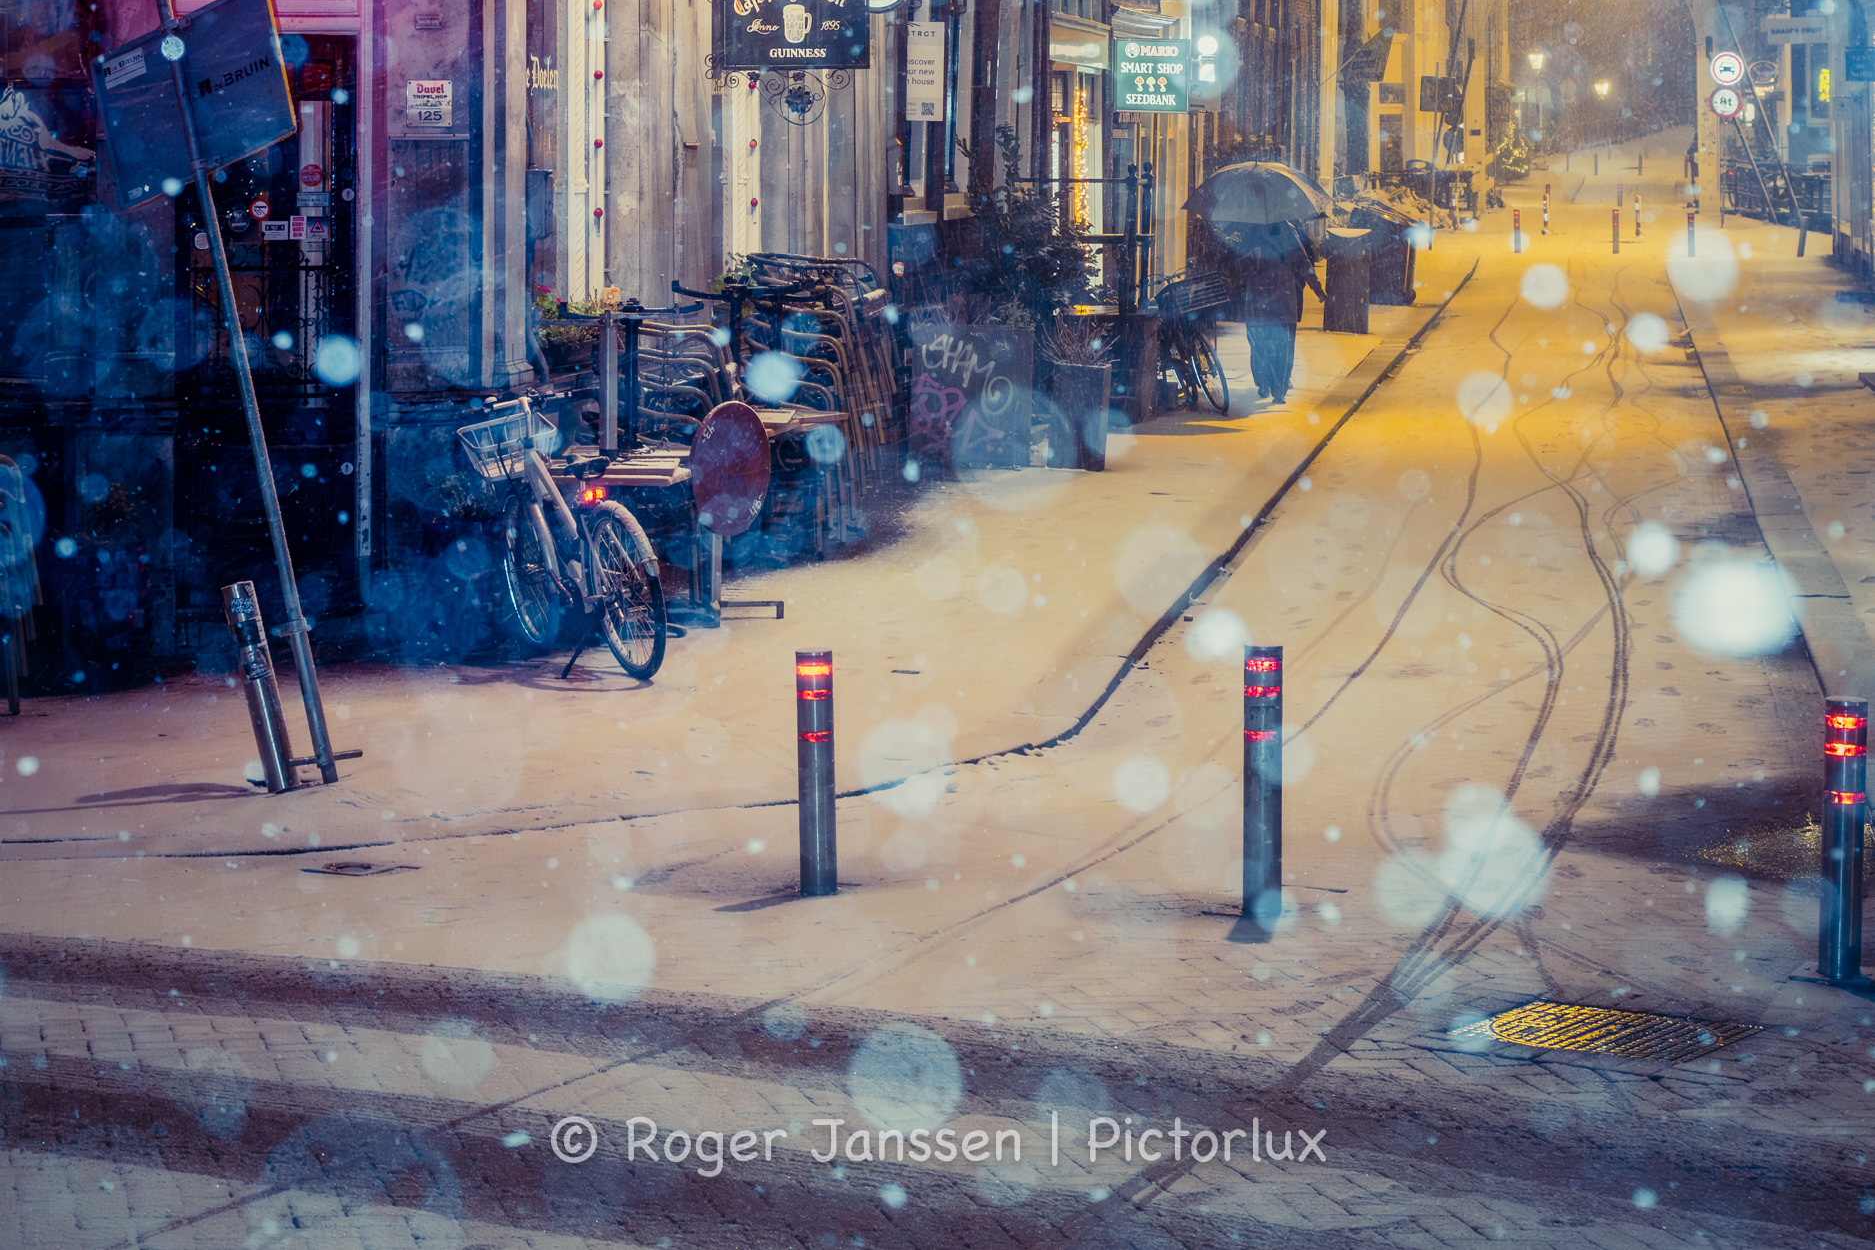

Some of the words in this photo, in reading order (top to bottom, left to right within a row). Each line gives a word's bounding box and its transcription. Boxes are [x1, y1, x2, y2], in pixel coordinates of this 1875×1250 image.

[746, 18, 780, 35] Anno
[820, 20, 841, 31] 1895
[769, 48, 827, 59] GUINNESS
[1140, 45, 1179, 57] MARIO
[119, 53, 144, 69] BRUIN
[907, 58, 935, 66] iscover
[223, 56, 270, 87] BRUIN
[1120, 62, 1154, 74] SMART
[1157, 62, 1184, 75] SHOP
[416, 83, 445, 94] Duvel
[1125, 93, 1176, 106] SEEDBANK
[417, 110, 442, 121] 125
